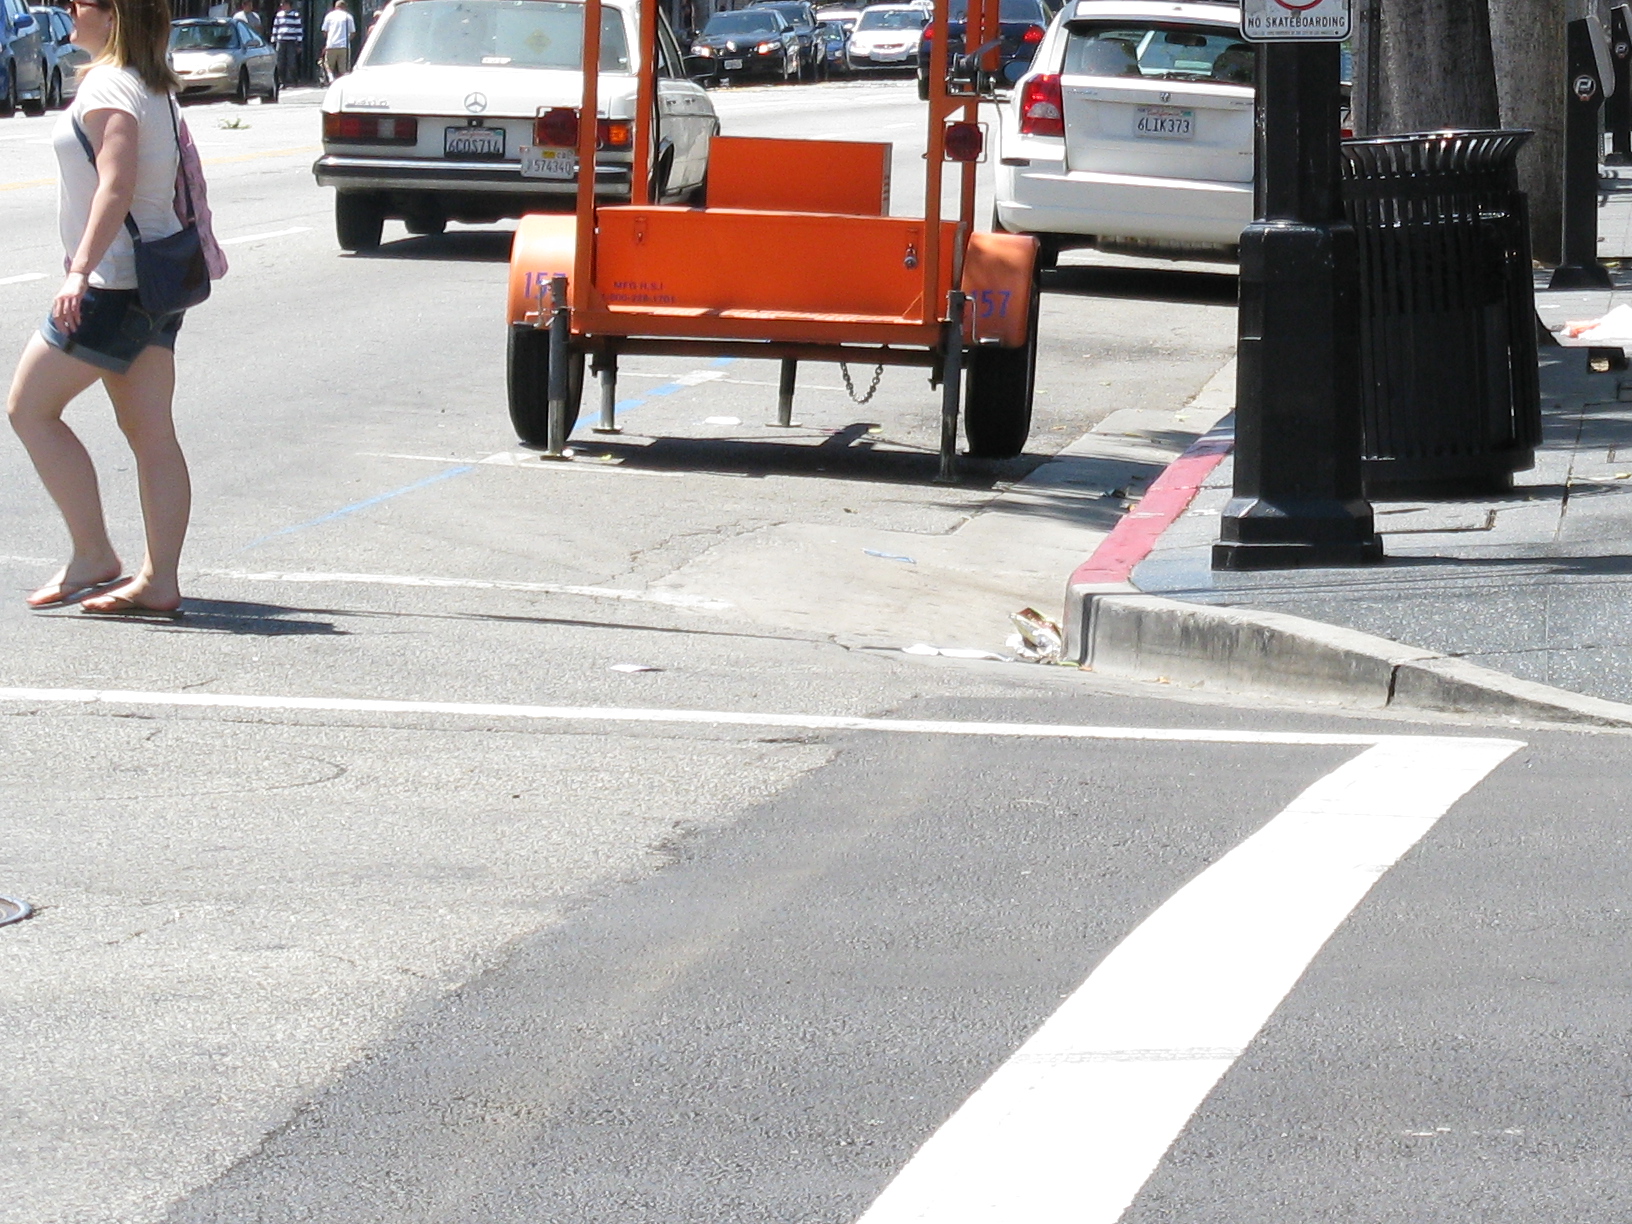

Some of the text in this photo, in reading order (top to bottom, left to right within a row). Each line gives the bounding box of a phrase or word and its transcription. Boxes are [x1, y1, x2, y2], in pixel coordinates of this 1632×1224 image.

[1248, 16, 1345, 28] NO SKATEBOARDING
[1138, 117, 1189, 133] 6LIK373
[524, 272, 566, 299] 15
